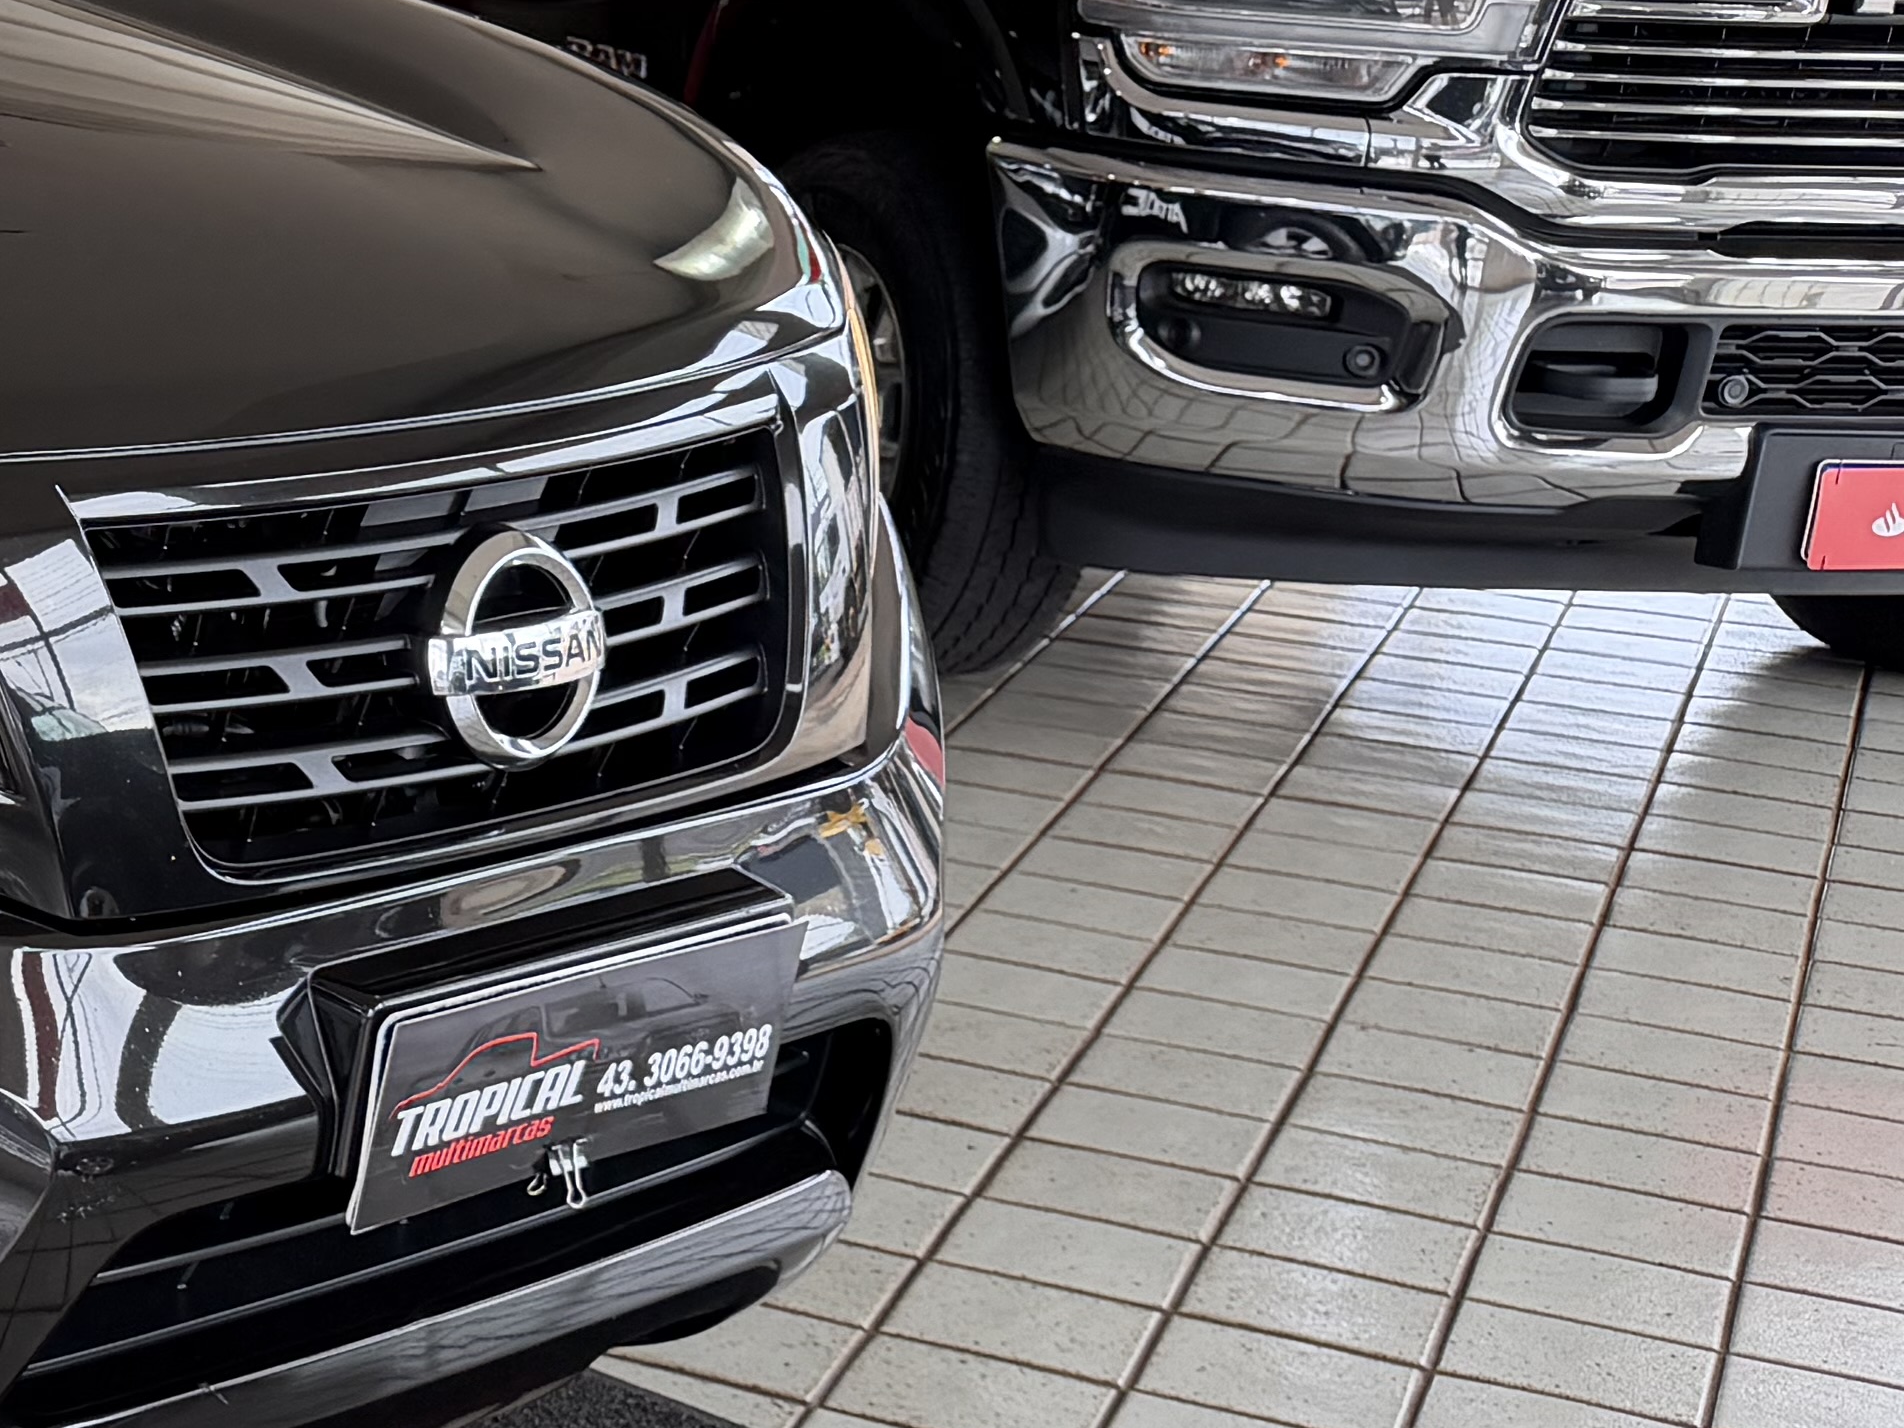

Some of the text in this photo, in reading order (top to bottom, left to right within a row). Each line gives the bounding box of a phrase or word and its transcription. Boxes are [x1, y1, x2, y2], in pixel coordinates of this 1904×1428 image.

[465, 628, 603, 682] NISSAN
[643, 1023, 773, 1088] 3066-9398
[391, 1059, 587, 1157] TROPICAL
[408, 1115, 556, 1178] multimarcas
